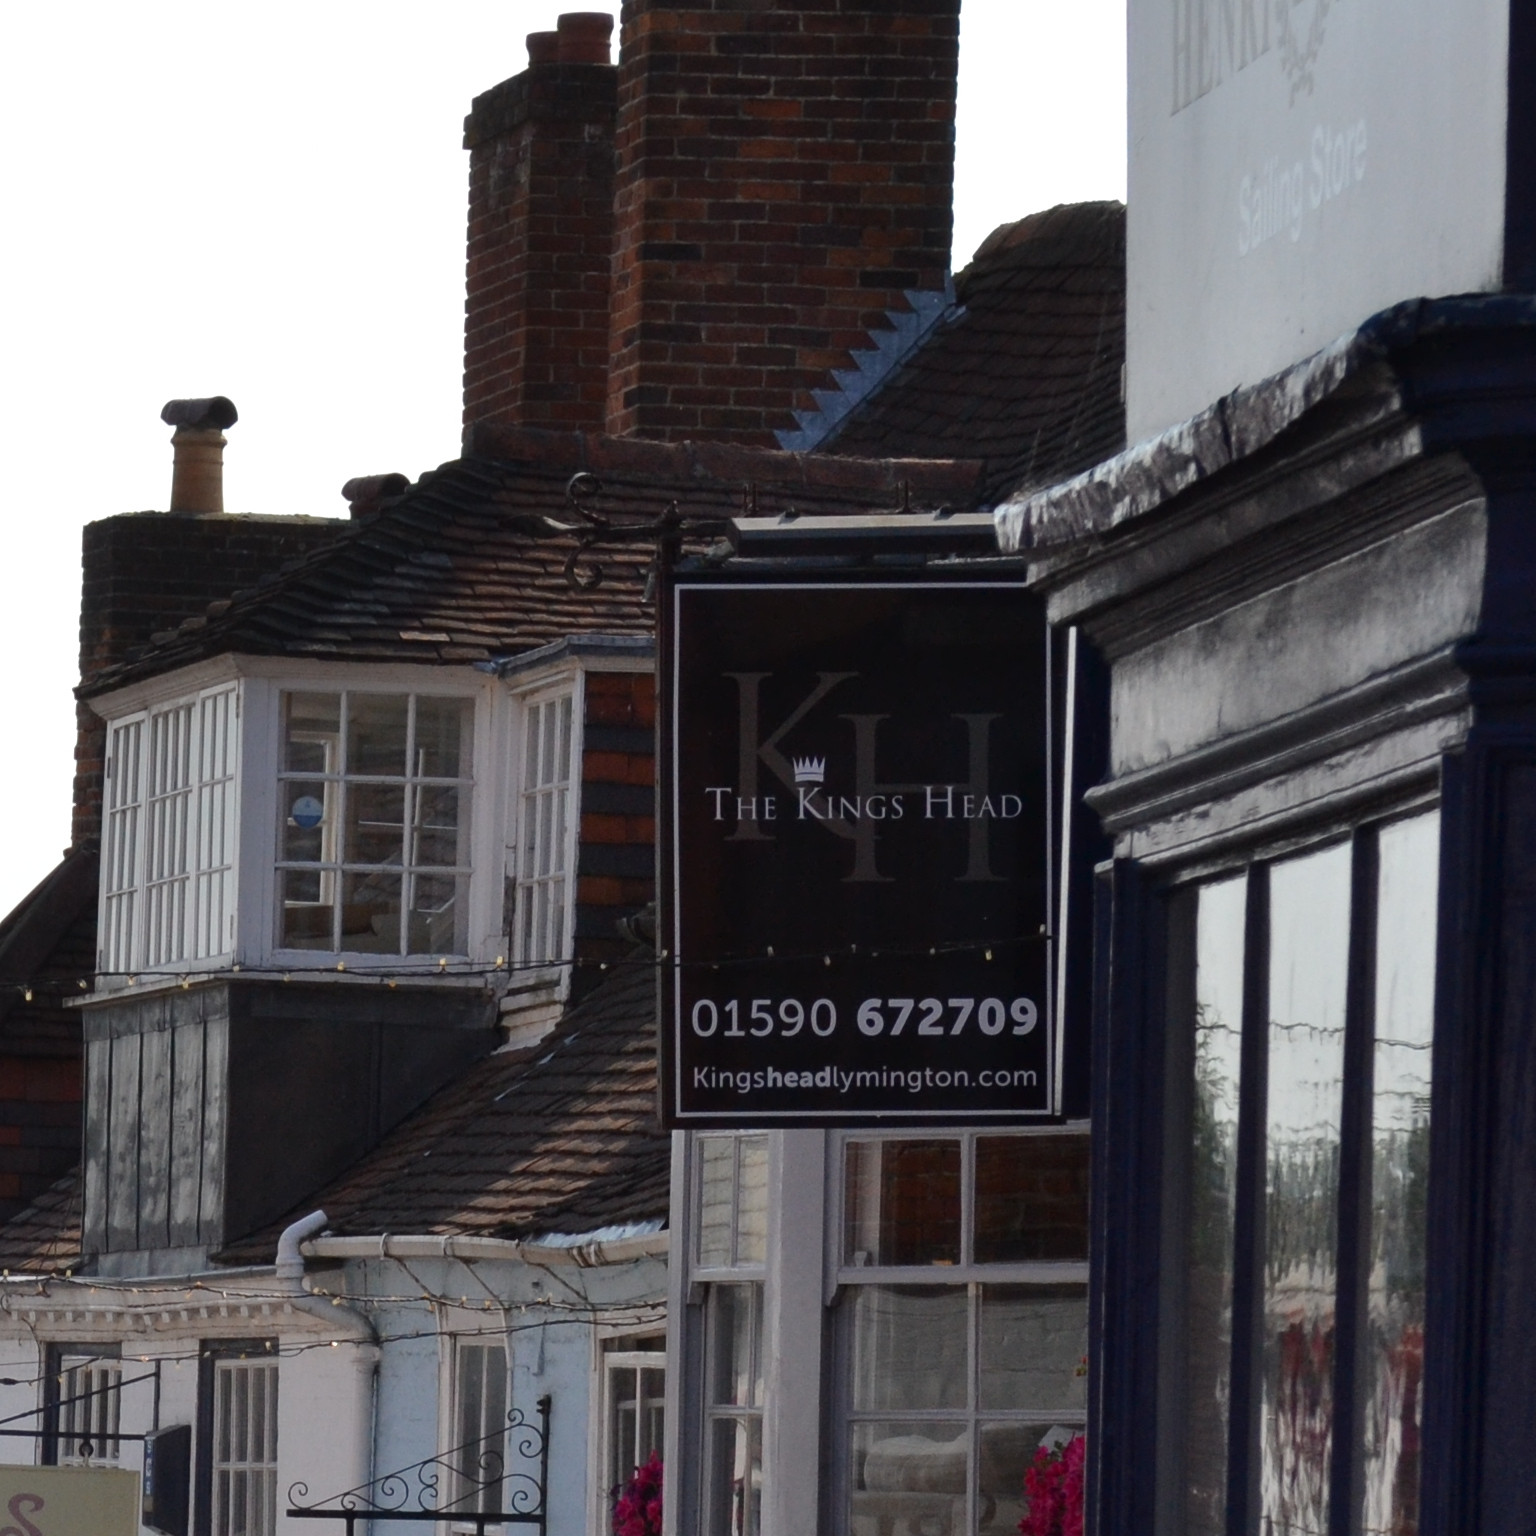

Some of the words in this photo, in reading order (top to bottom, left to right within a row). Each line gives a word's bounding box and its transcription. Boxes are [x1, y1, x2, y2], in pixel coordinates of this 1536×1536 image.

[1238, 155, 1303, 257] Sailing
[1310, 118, 1368, 211] Store
[691, 998, 837, 1038] 01590
[856, 997, 1039, 1036] 672709
[693, 1065, 1038, 1095] Kingsheadlymington.com
